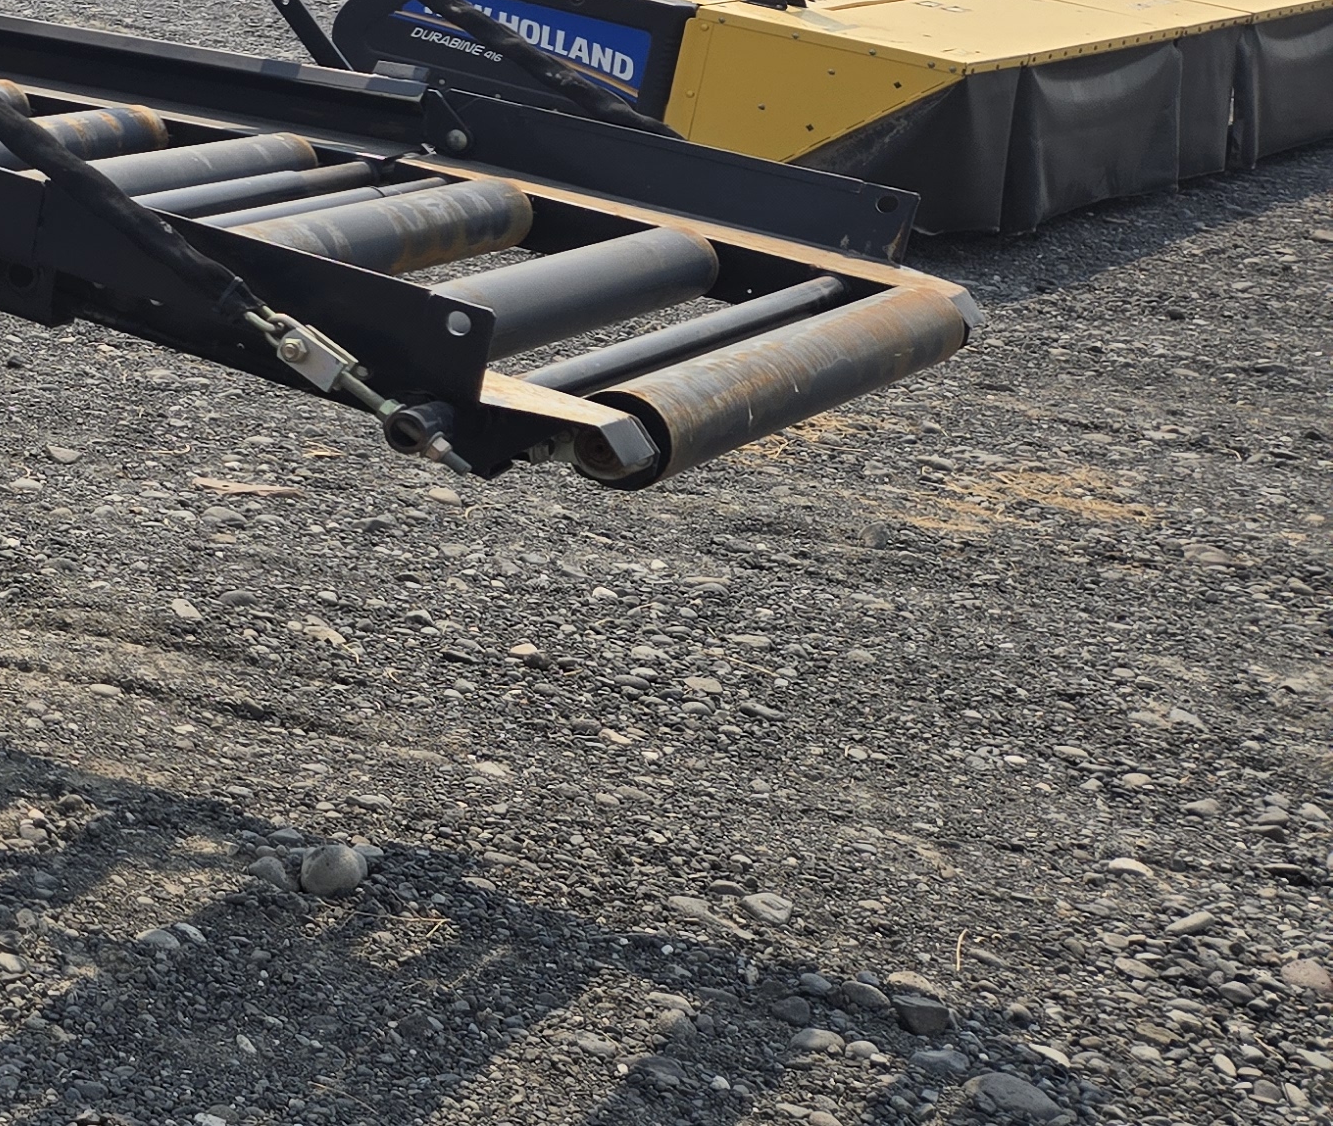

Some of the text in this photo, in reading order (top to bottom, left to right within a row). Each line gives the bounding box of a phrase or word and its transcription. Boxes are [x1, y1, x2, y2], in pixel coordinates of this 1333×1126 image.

[410, 26, 503, 62] DURABINE 416
[498, 11, 634, 81] HOLLAND
